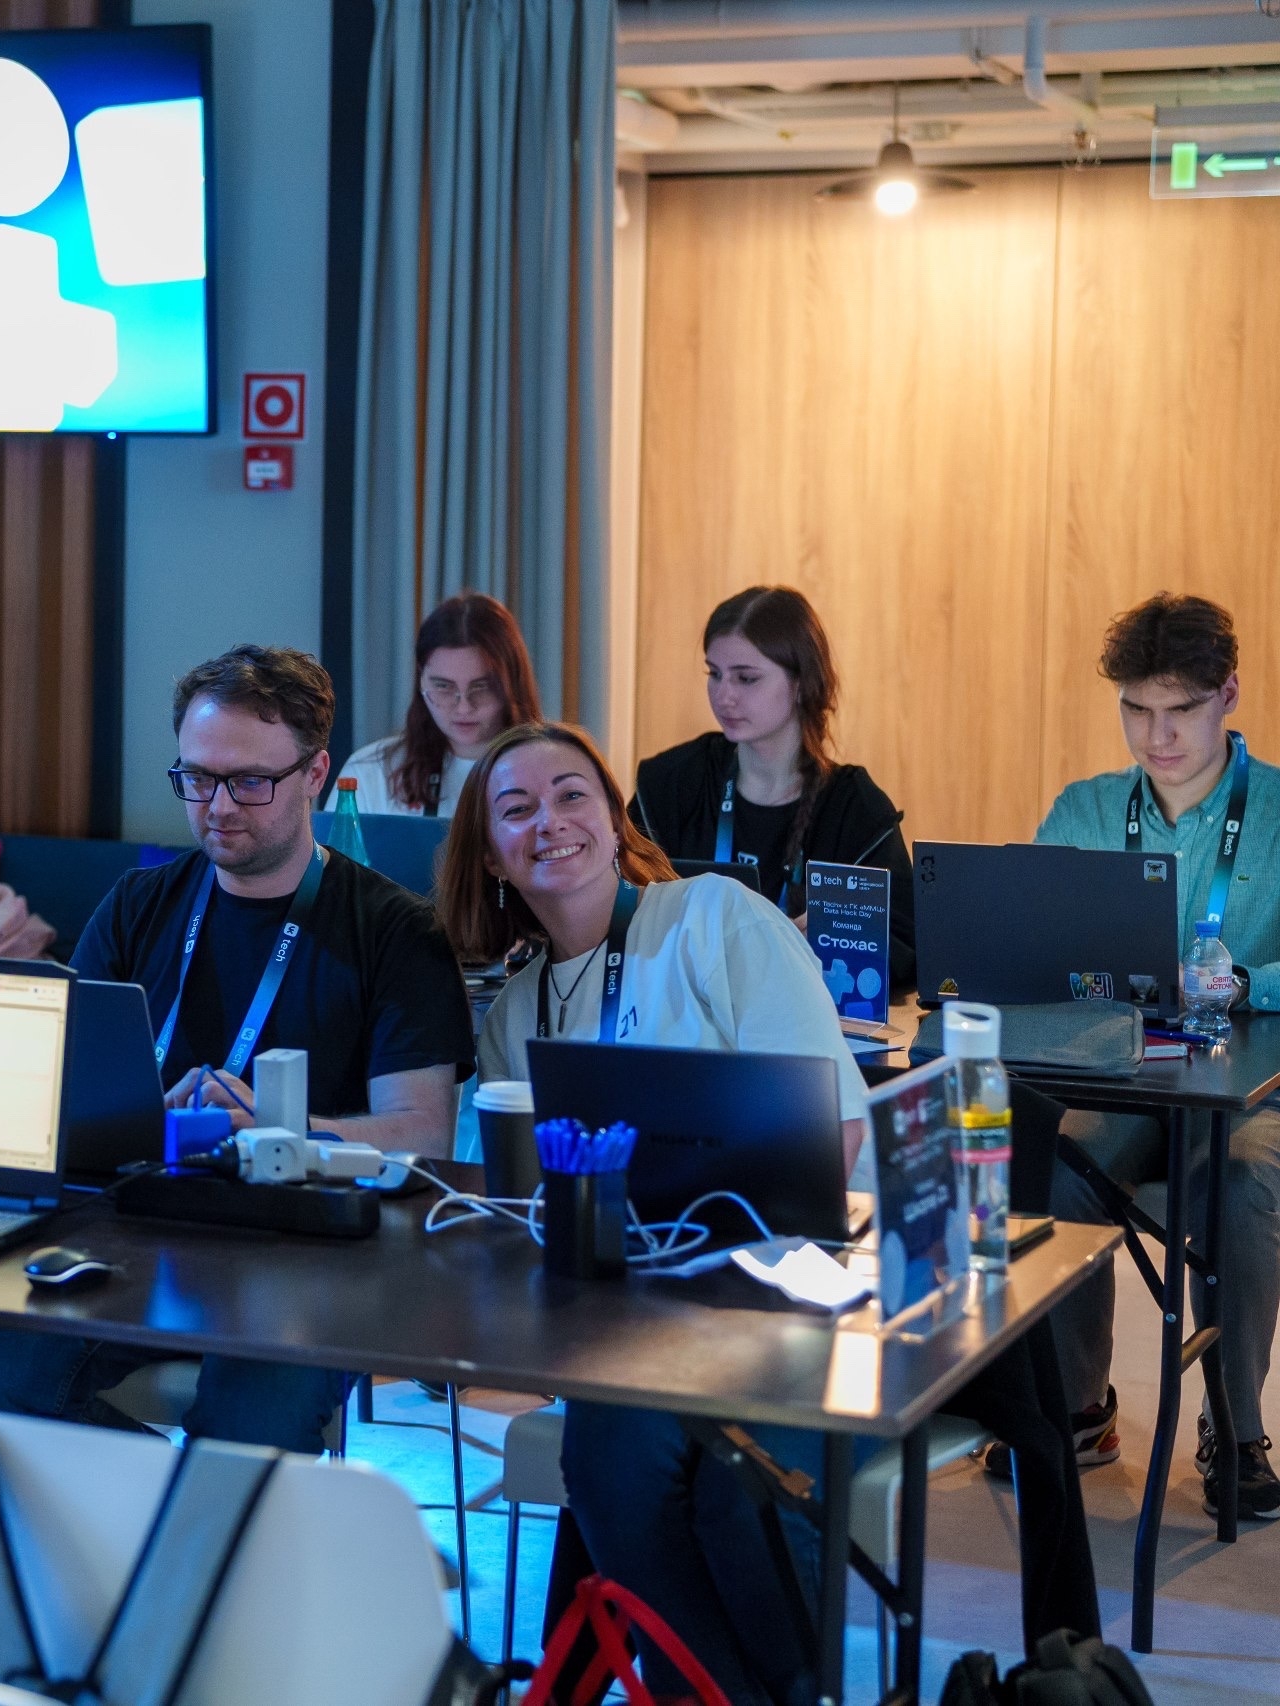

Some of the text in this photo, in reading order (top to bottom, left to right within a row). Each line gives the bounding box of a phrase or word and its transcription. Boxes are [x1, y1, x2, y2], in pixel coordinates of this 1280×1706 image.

[1223, 834, 1235, 856] tech
[823, 875, 843, 886] tech
[823, 907, 872, 919] Data Hack Day
[189, 914, 200, 938] tech
[832, 920, 862, 931] Команда
[275, 939, 292, 962] tech
[817, 933, 878, 952] Стохас
[607, 970, 618, 995] tech
[231, 1043, 248, 1066] tech
